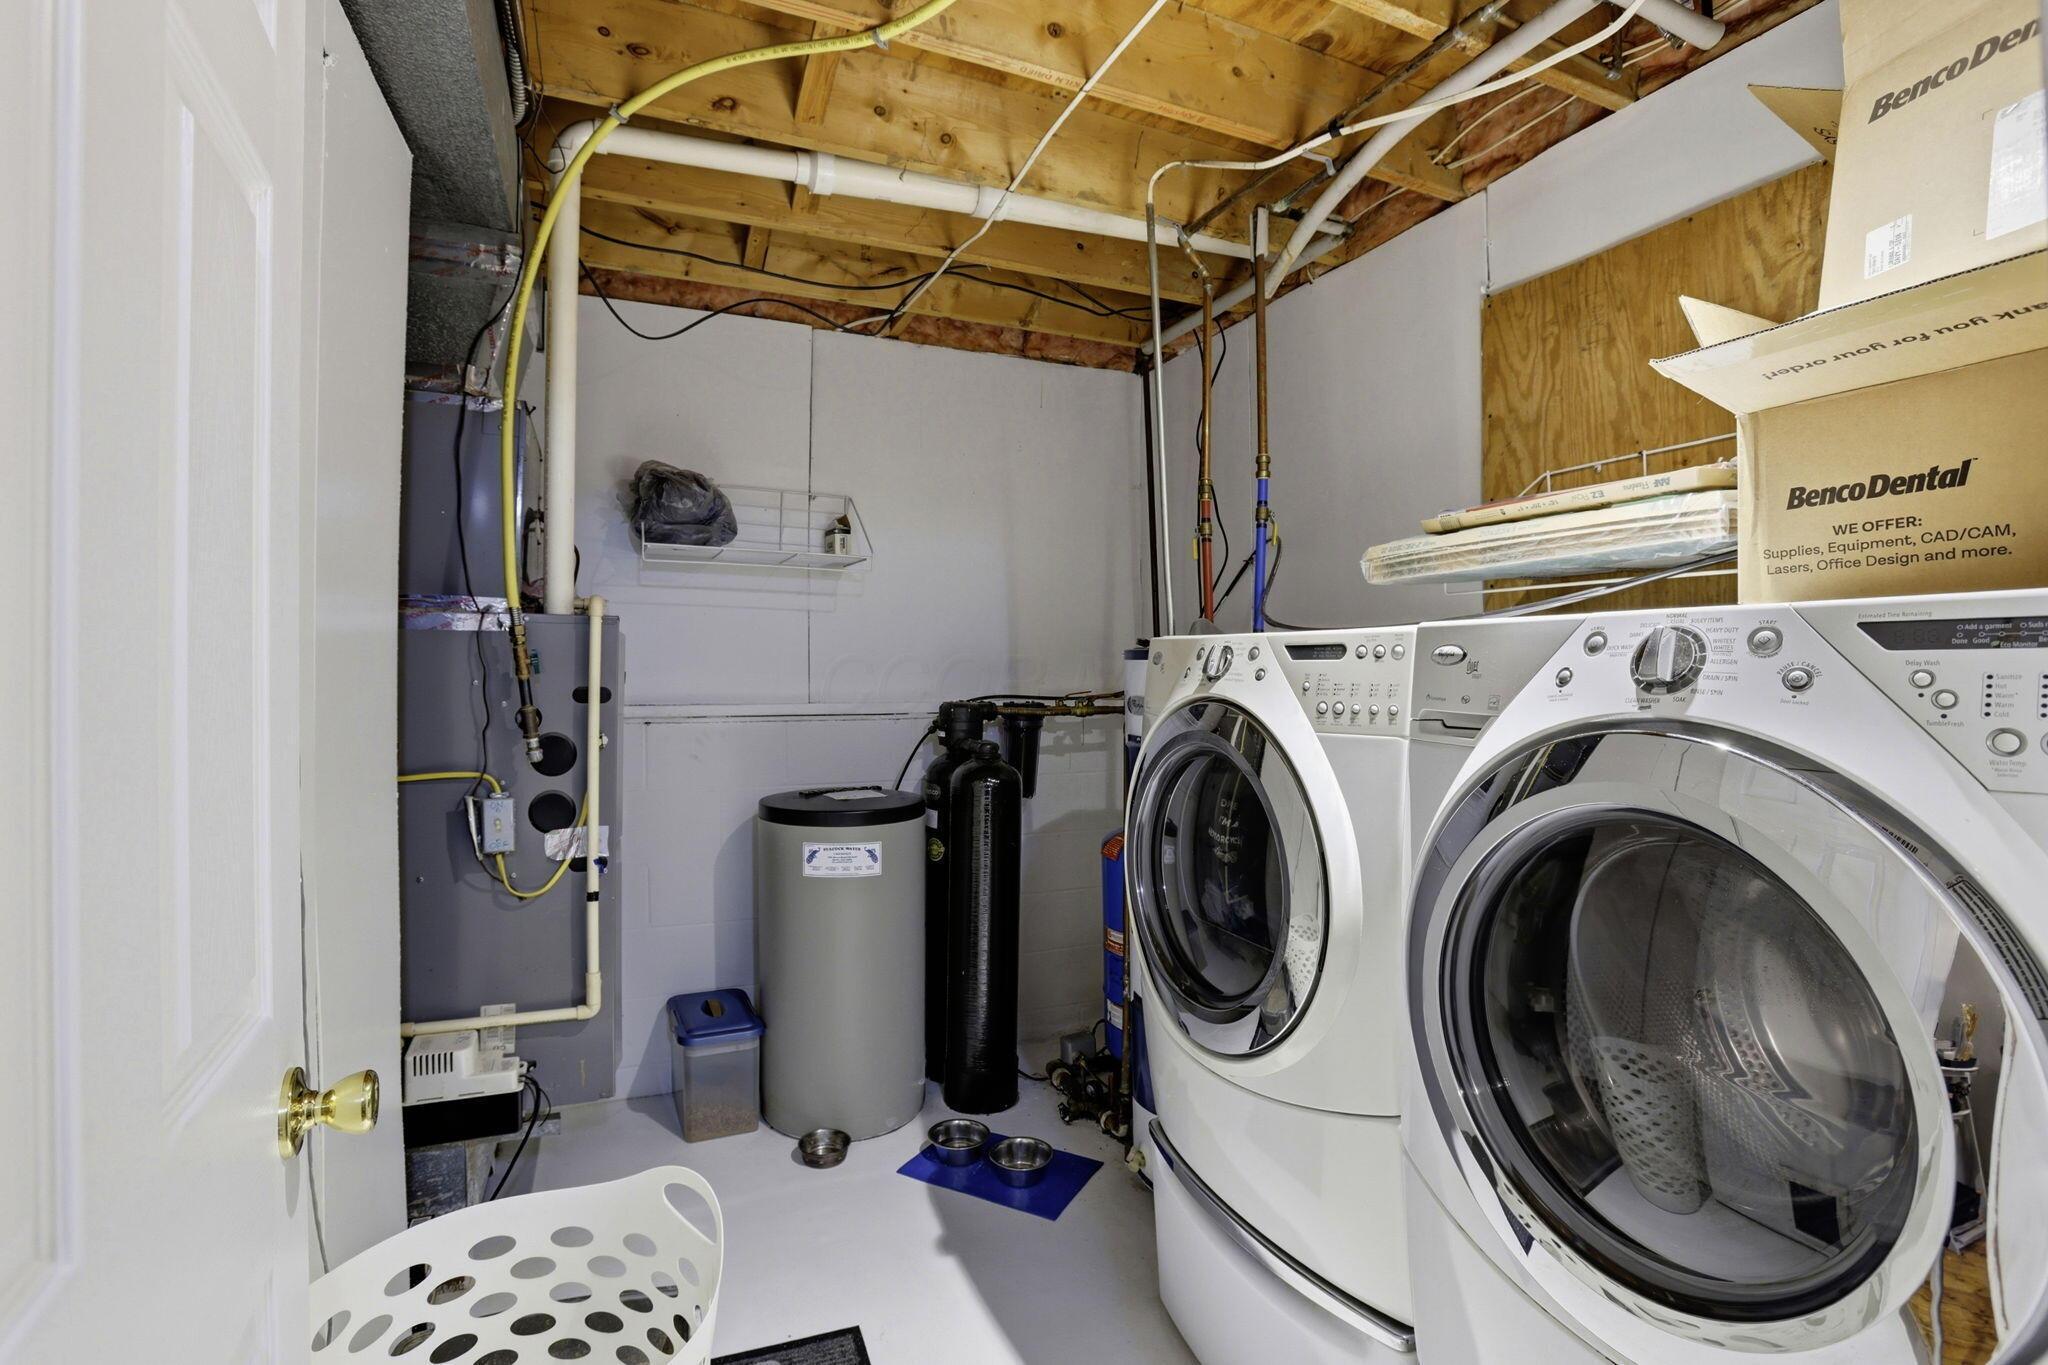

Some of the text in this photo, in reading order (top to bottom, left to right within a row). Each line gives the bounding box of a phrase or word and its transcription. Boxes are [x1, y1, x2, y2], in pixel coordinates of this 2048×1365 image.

[1933, 316, 1988, 338] you
[1892, 330, 1932, 347] for
[1833, 341, 1887, 362] your
[1763, 356, 1827, 381] order!
[1832, 516, 1923, 536] WE OFFER:
[1763, 524, 2017, 560] Supplies, Equipment, CAD/CAM,
[1766, 542, 2013, 576] Lasers, Office Design and more.
[1984, 622, 2012, 631] garment
[1776, 661, 1794, 675] PAUSE
[1801, 661, 1823, 678] CANCEL
[1905, 659, 1922, 667] Delay
